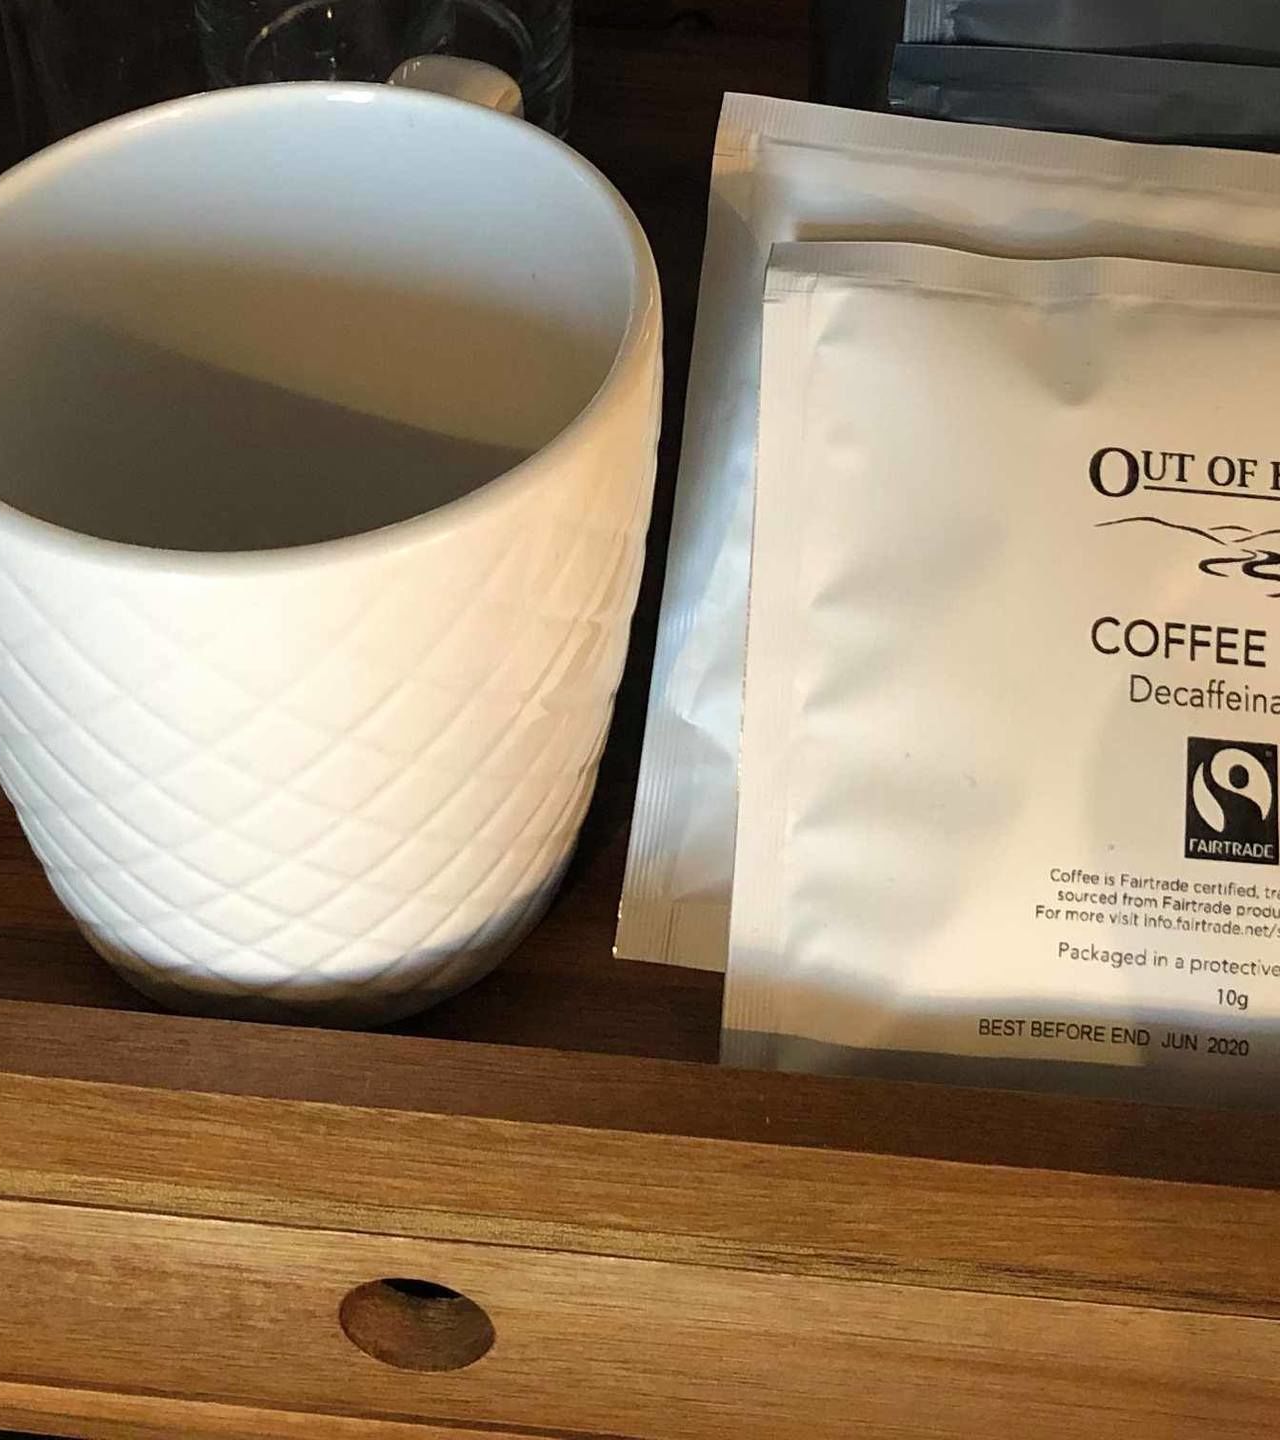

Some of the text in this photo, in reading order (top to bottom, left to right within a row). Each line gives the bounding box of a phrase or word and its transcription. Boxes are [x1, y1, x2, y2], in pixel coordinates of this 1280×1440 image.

[1089, 447, 1195, 497] OUT
[1207, 455, 1257, 489] OF
[1091, 616, 1267, 669] COFFEE
[1189, 838, 1275, 860] FAIRTRADE
[1050, 868, 1100, 885] Coffee
[1104, 873, 1116, 886] is
[1120, 873, 1189, 893] Fairtrade
[1193, 880, 1260, 900] certified,
[1035, 904, 1061, 920] For
[1065, 910, 1105, 923] more
[1109, 911, 1139, 927] visit
[1057, 889, 1118, 906] sourced
[1122, 892, 1158, 909] from
[1162, 895, 1232, 916] Fairtrade
[1058, 941, 1147, 968] Packaged
[1153, 950, 1168, 968] in
[1175, 957, 1185, 969] a
[1216, 987, 1250, 1010] 10g
[978, 1018, 1026, 1037] BEST
[1030, 1021, 1106, 1043] BEFORE
[1111, 1027, 1150, 1047] END
[1161, 1032, 1198, 1052] JUN
[1207, 1036, 1249, 1057] 2020
